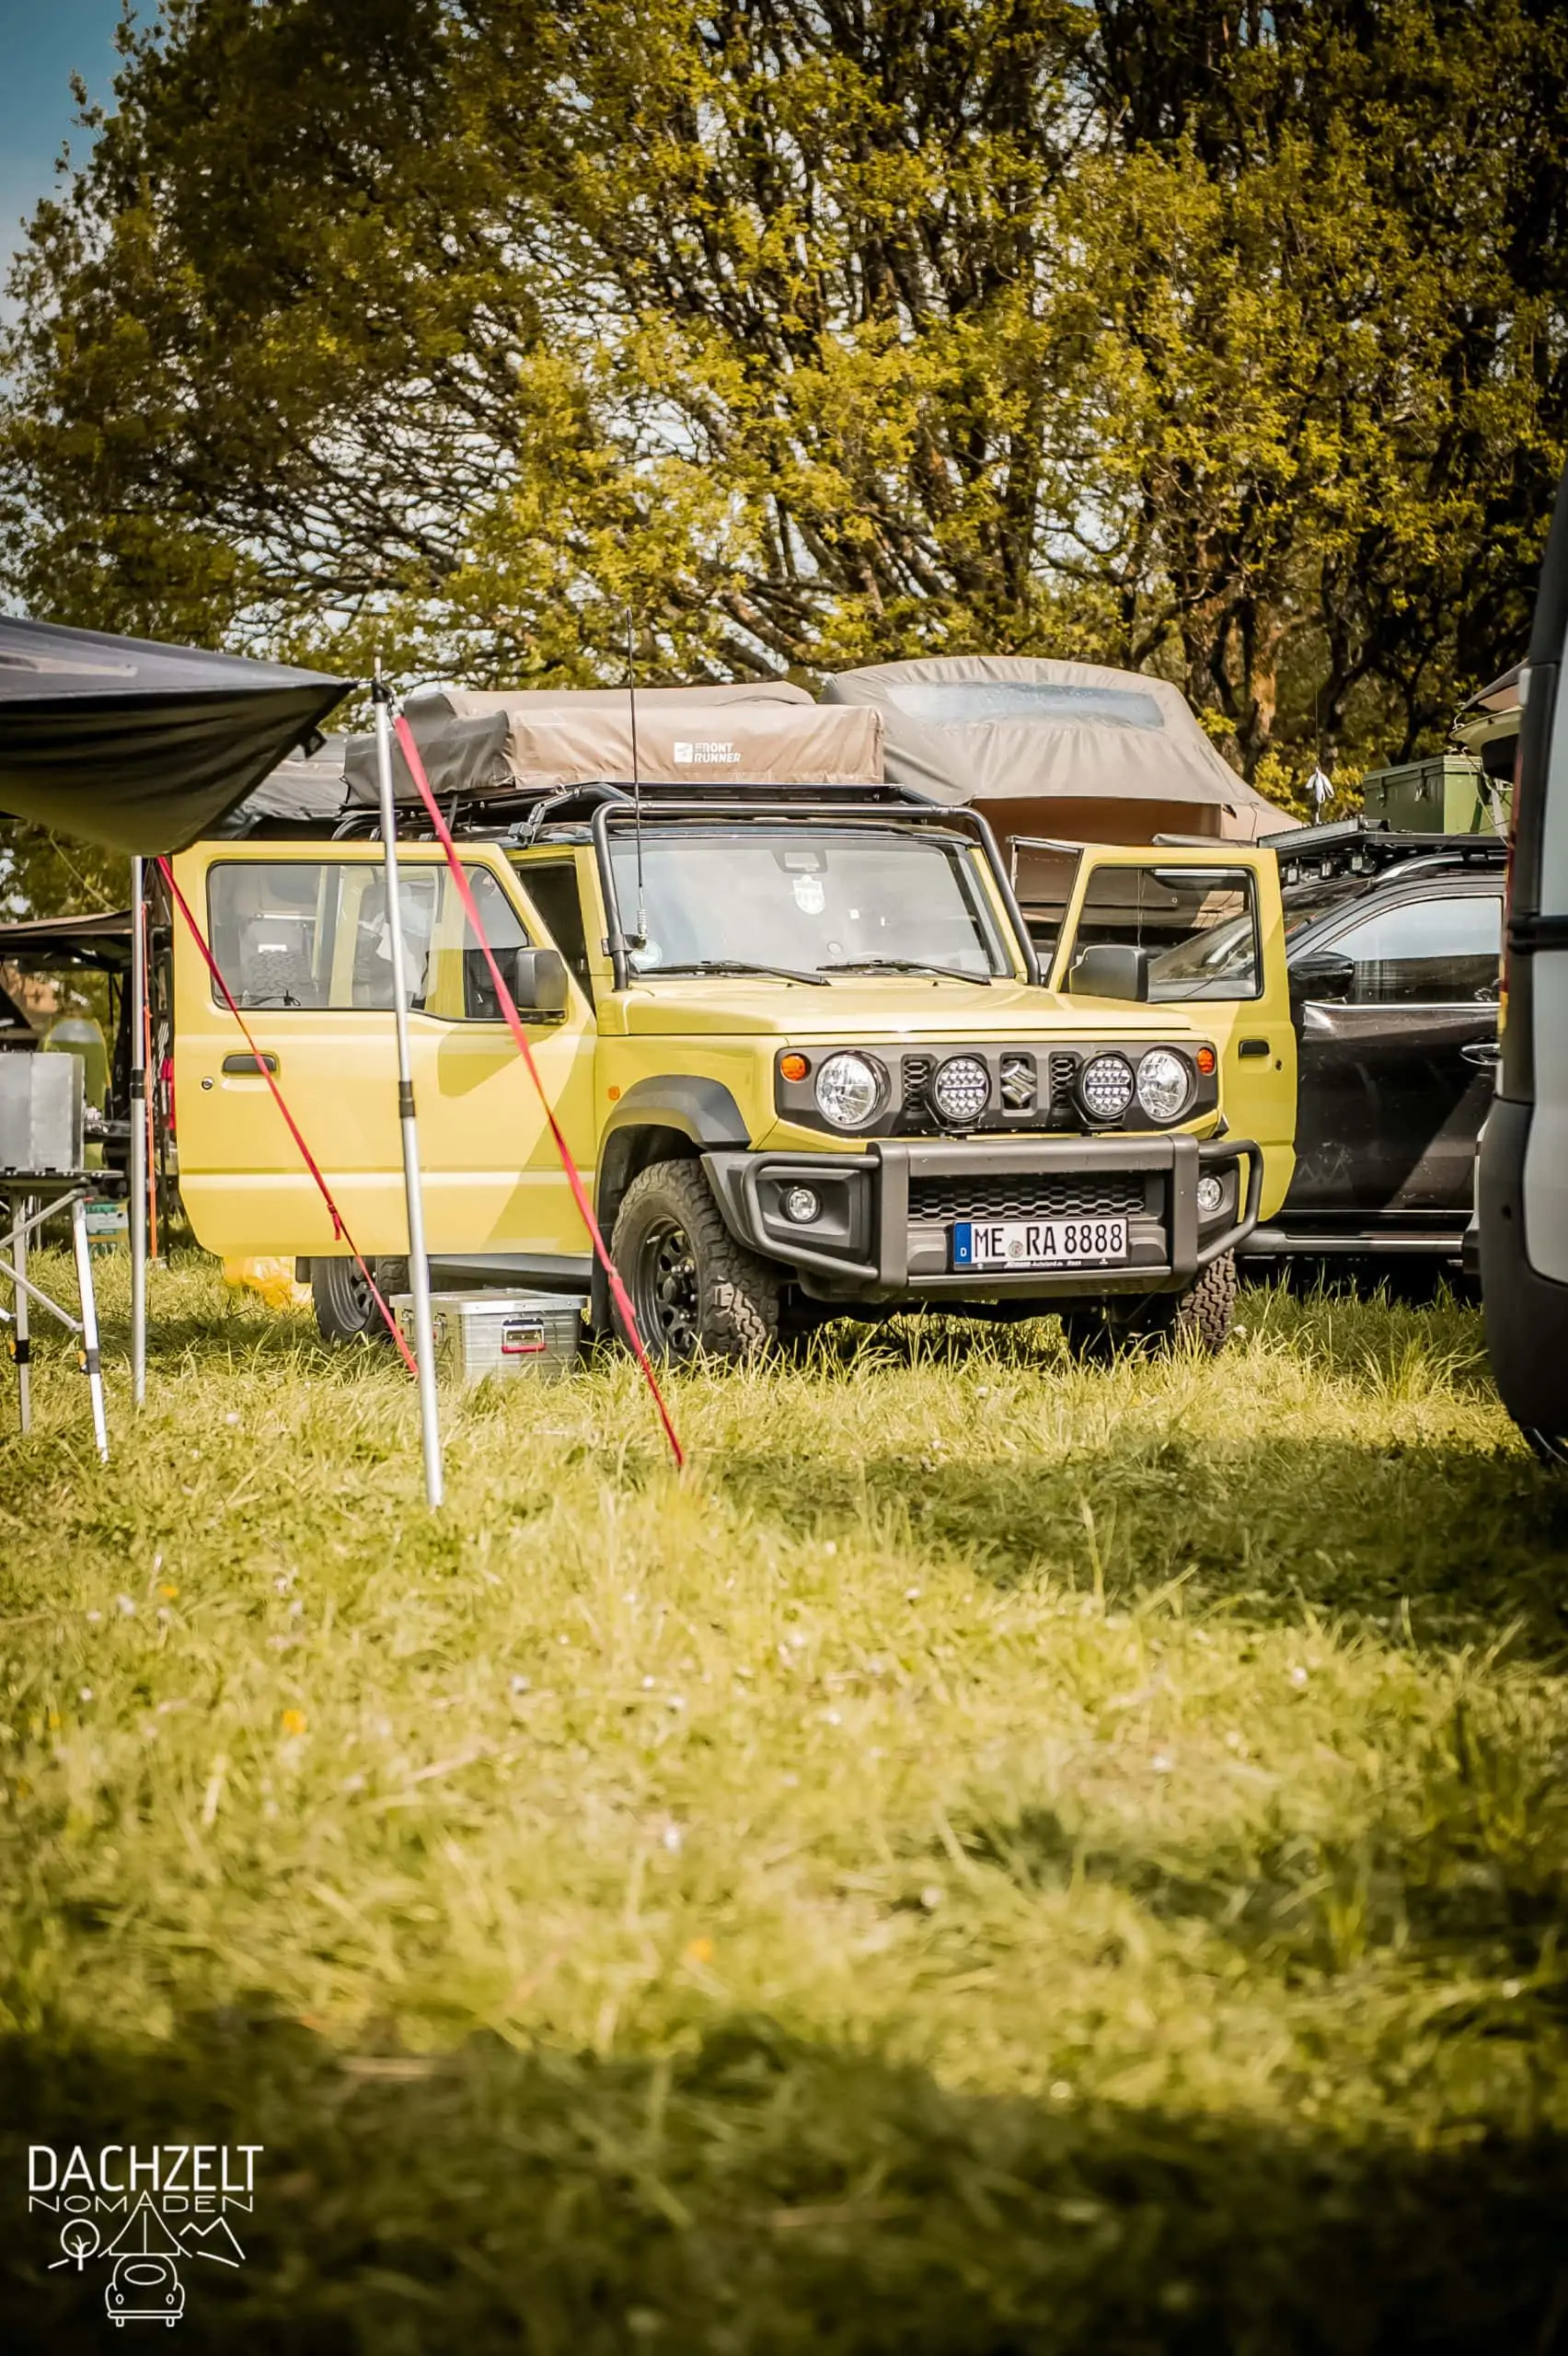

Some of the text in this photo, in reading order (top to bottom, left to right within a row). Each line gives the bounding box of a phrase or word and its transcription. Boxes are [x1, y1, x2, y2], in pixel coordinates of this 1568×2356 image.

[694, 742, 734, 753] FRONT
[694, 753, 742, 763] RUNNER
[974, 1223, 1123, 1258] ME RA 8888
[960, 1247, 967, 1257] D
